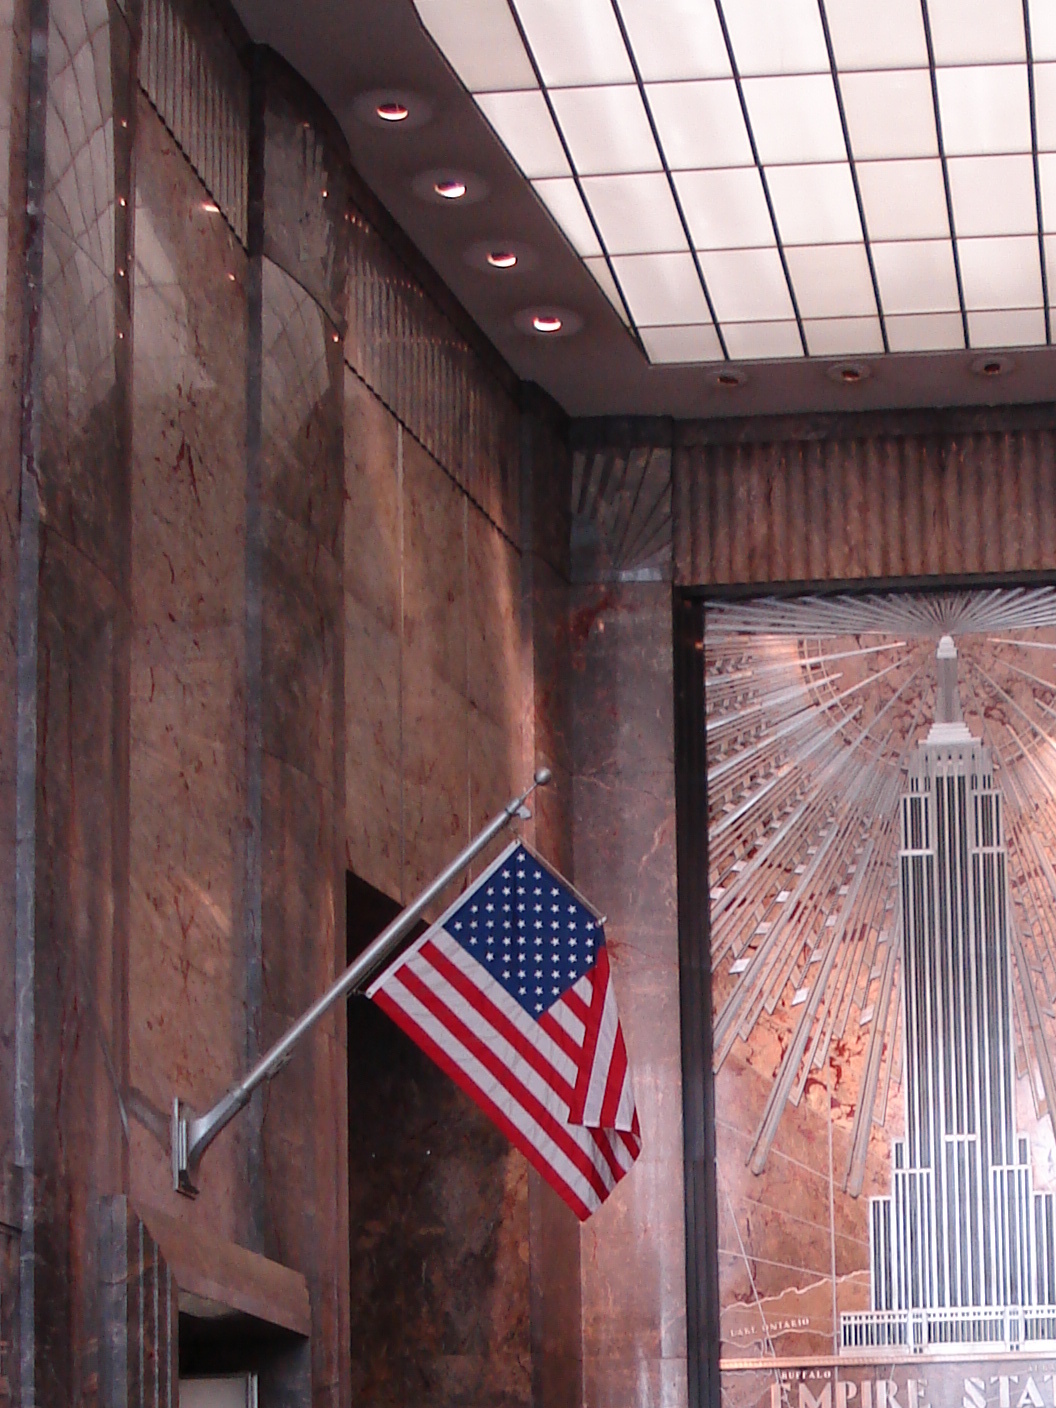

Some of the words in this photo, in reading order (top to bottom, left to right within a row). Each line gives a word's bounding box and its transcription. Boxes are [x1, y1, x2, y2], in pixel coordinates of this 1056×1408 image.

[730, 1325, 757, 1337] LAKE
[762, 1316, 810, 1333] ONTARIO
[781, 1370, 831, 1379] BUFFALO
